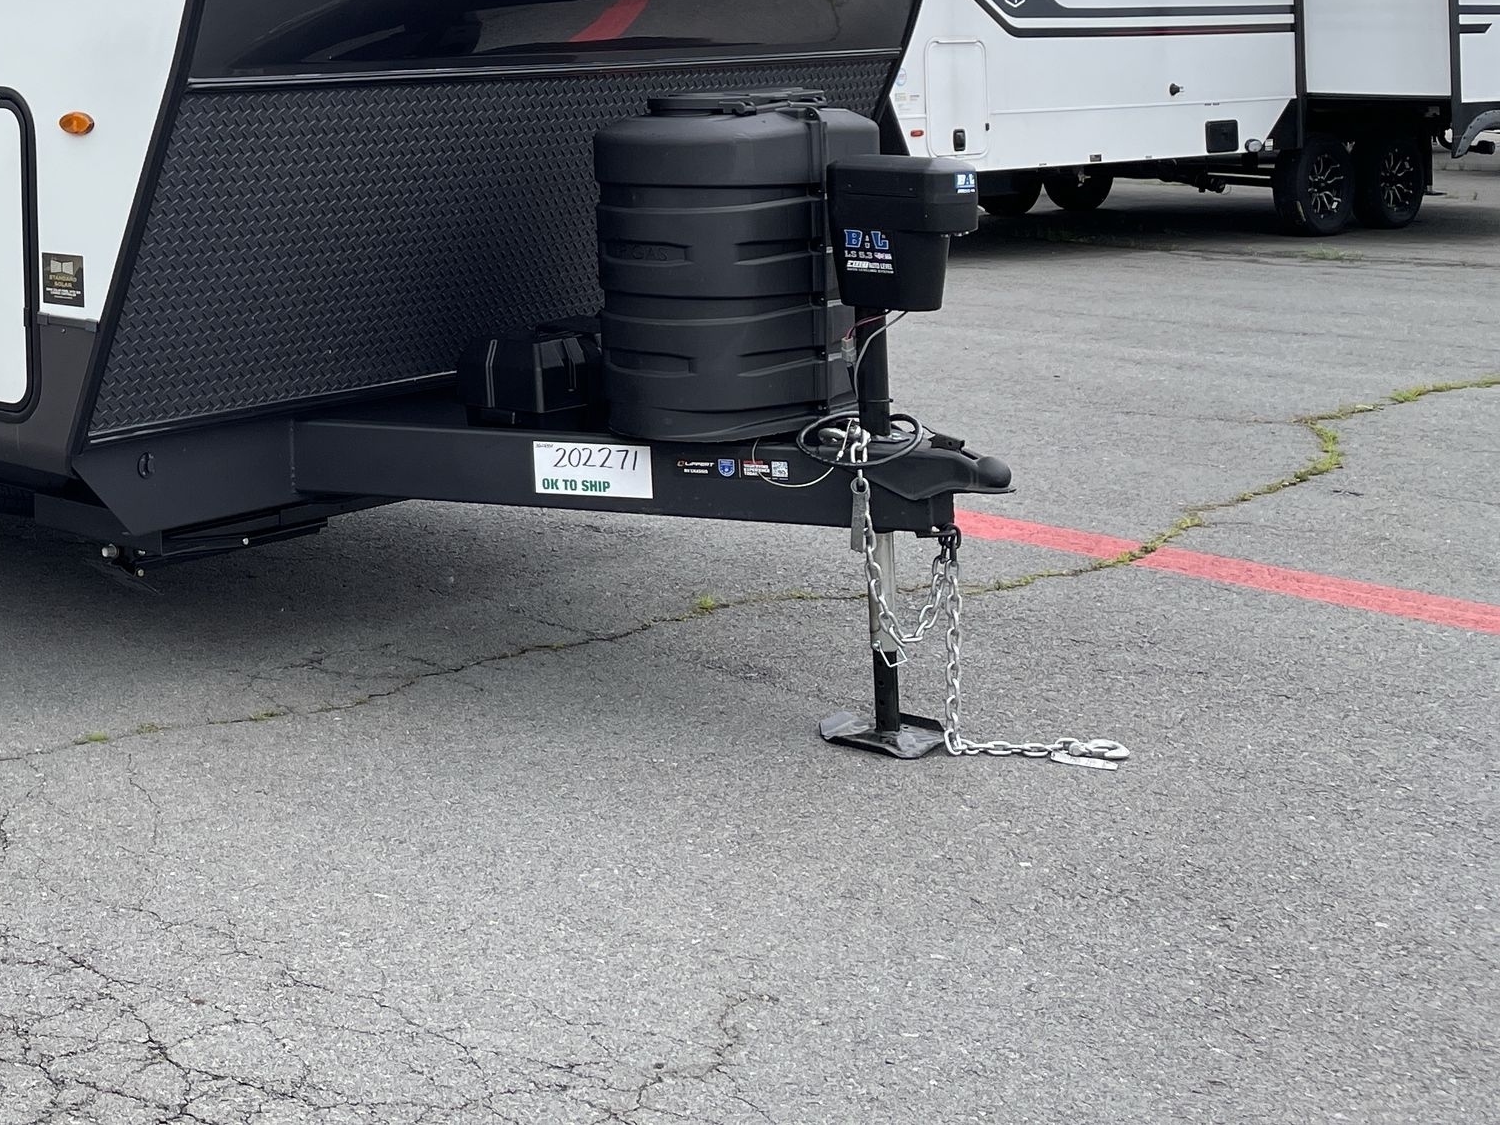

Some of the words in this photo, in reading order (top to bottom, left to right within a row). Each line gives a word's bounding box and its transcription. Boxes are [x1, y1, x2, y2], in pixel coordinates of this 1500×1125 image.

[553, 447, 638, 471] 202271
[542, 478, 559, 490] OK
[562, 479, 577, 491] TO
[581, 480, 610, 492] SHIP
